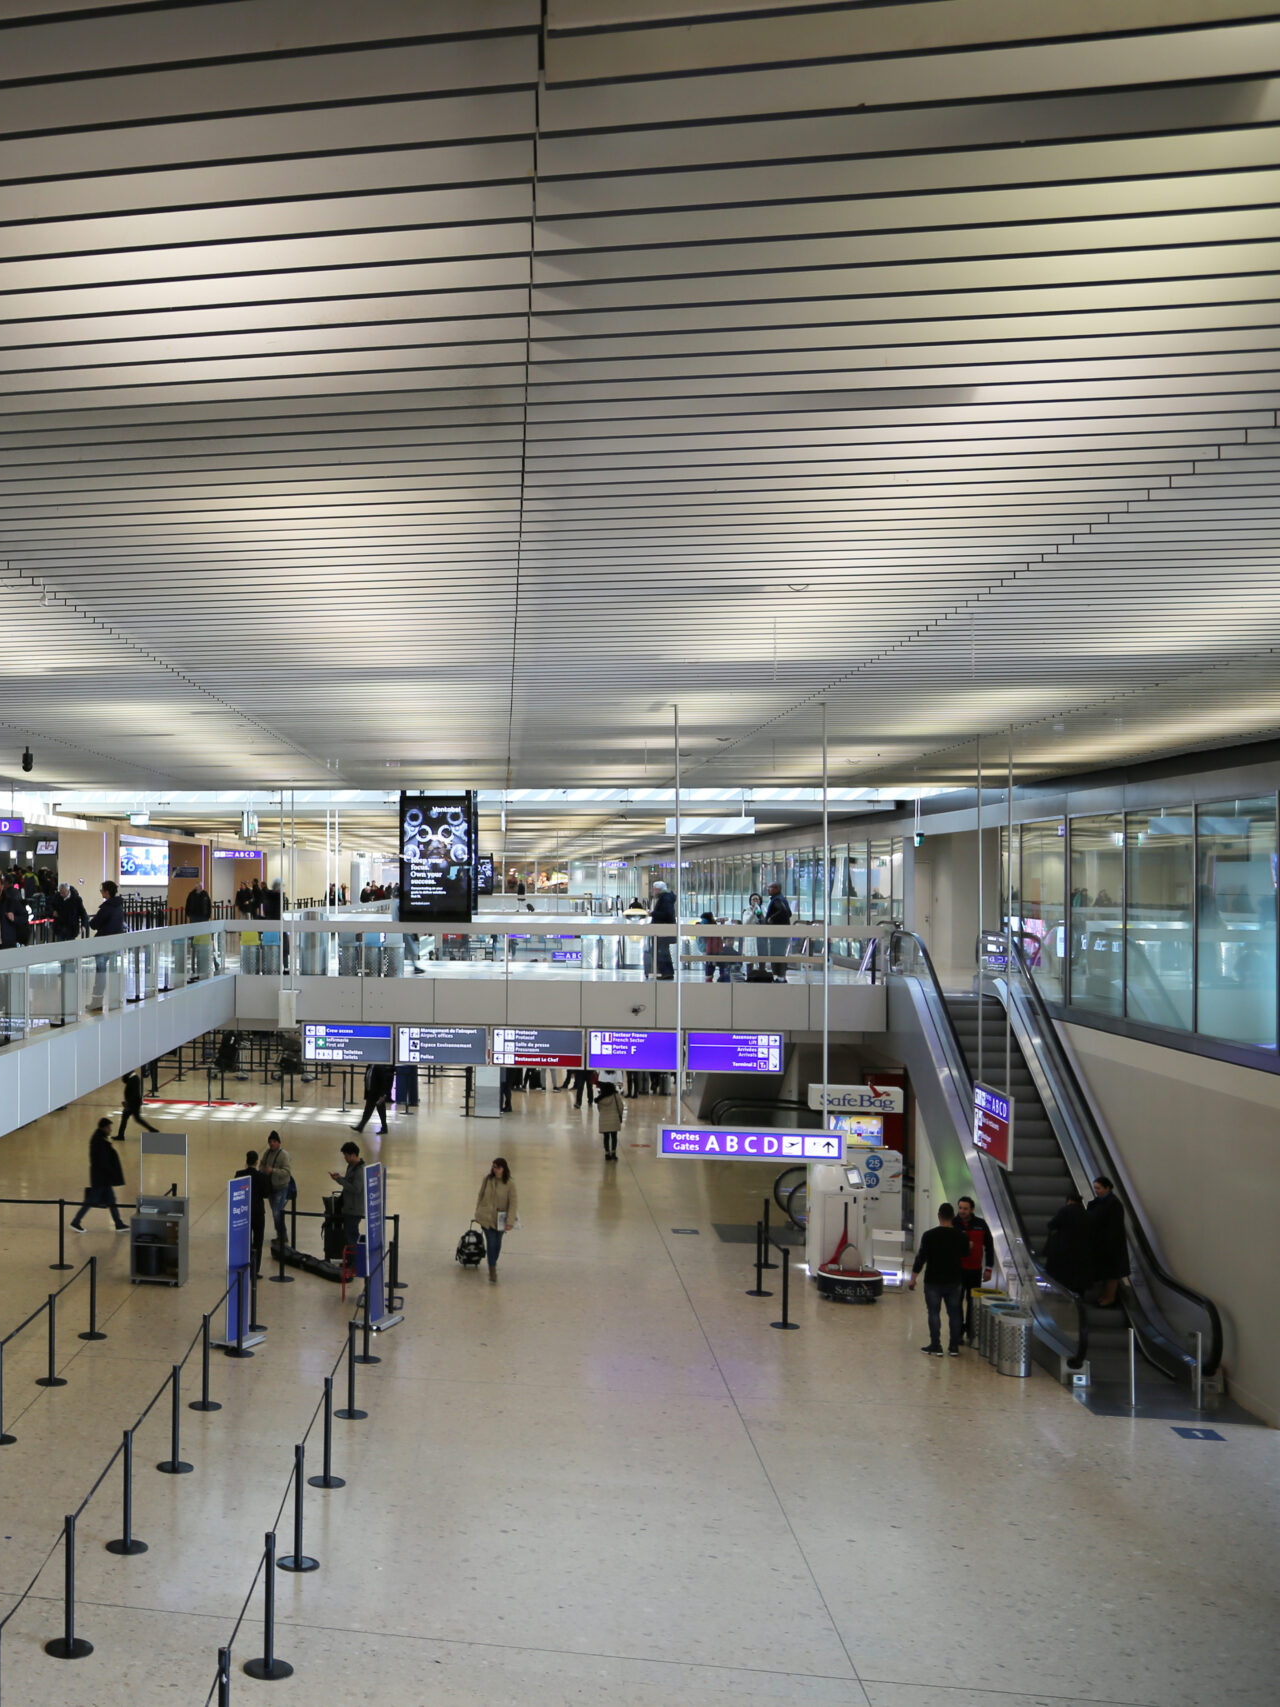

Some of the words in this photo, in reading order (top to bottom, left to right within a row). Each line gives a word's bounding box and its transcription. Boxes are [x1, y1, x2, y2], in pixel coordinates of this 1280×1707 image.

[1, 821, 10, 831] D
[631, 1046, 637, 1055] F
[671, 1132, 700, 1141] Portes
[673, 1142, 700, 1151] Gates
[705, 1135, 720, 1152] A
[726, 1136, 738, 1152] B
[744, 1136, 757, 1153] C
[764, 1137, 778, 1153] D
